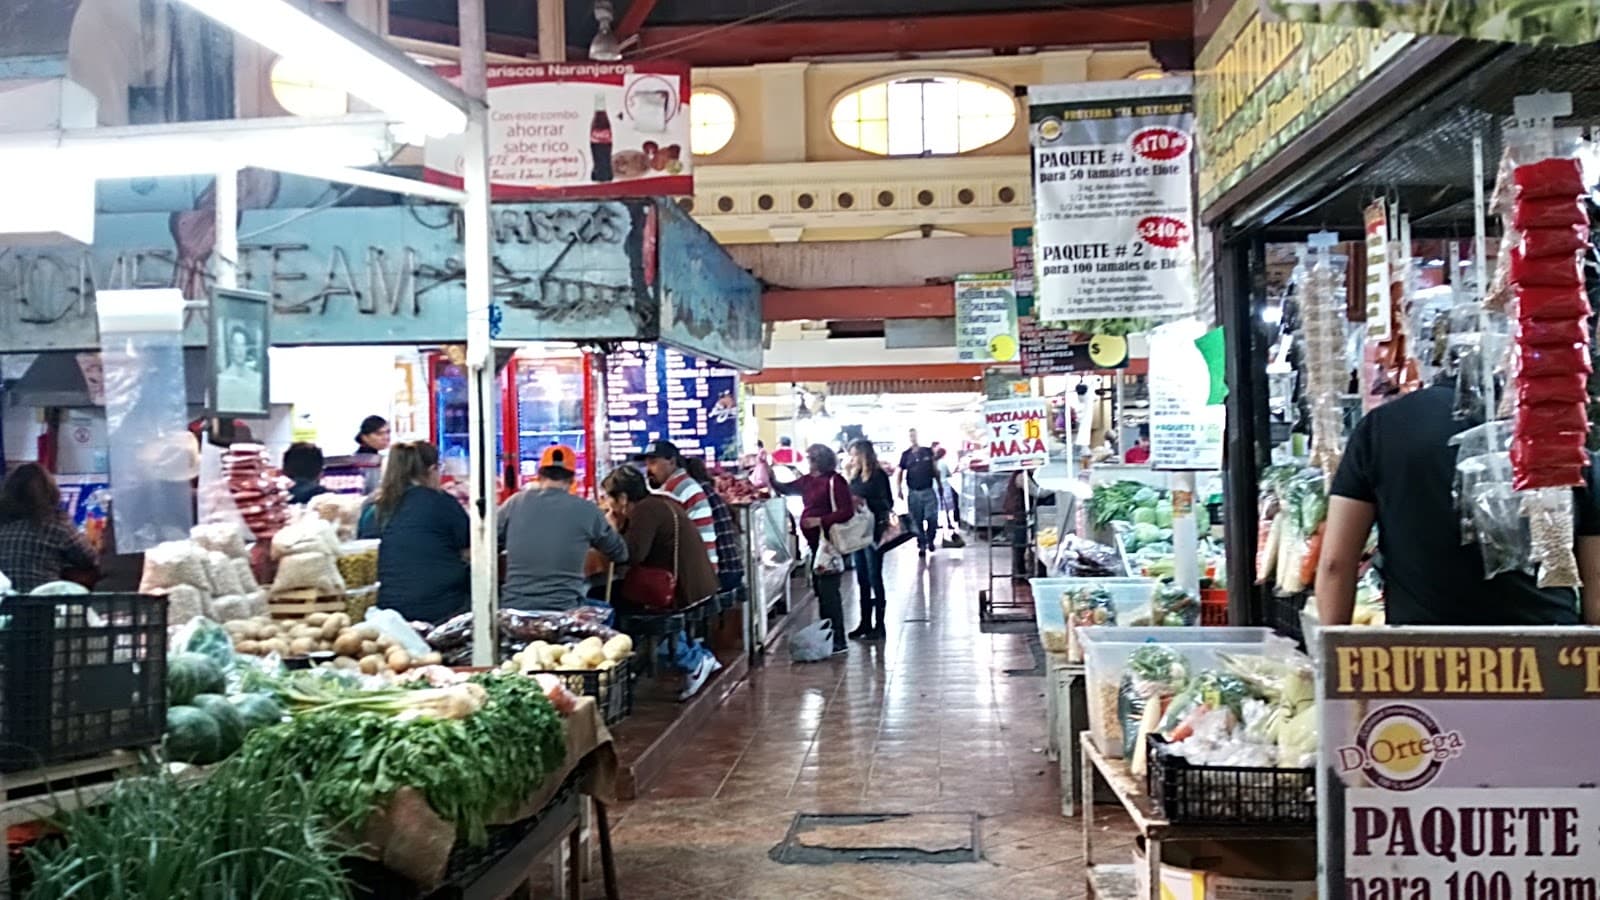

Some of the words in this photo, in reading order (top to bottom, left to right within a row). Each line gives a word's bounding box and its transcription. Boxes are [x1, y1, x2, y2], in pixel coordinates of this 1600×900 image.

[486, 65, 544, 77] ariscos
[548, 63, 634, 77] Naranjeros
[506, 123, 564, 137] ahorrar
[504, 140, 538, 152] sabe
[541, 140, 569, 152] rico
[1040, 150, 1106, 169] PAQUETE
[1040, 170, 1067, 183] para
[1069, 169, 1084, 180] 50
[1087, 167, 1132, 179] tamales
[1135, 165, 1149, 176] de
[1152, 163, 1180, 175] Elote
[1043, 243, 1109, 260] PAQUETE
[1115, 245, 1128, 256] #
[1133, 242, 1144, 256] 2
[1043, 264, 1069, 276] para
[1073, 263, 1092, 273] 100
[1096, 261, 1140, 273] tamales
[1143, 260, 1157, 270] de
[1092, 343, 1100, 355] $
[993, 426, 1001, 438] Y
[990, 438, 1046, 458] MASA
[1336, 647, 1544, 693] FRUTERIA
[1352, 807, 1580, 863] PAQUETE
[1445, 871, 1511, 900] 100
